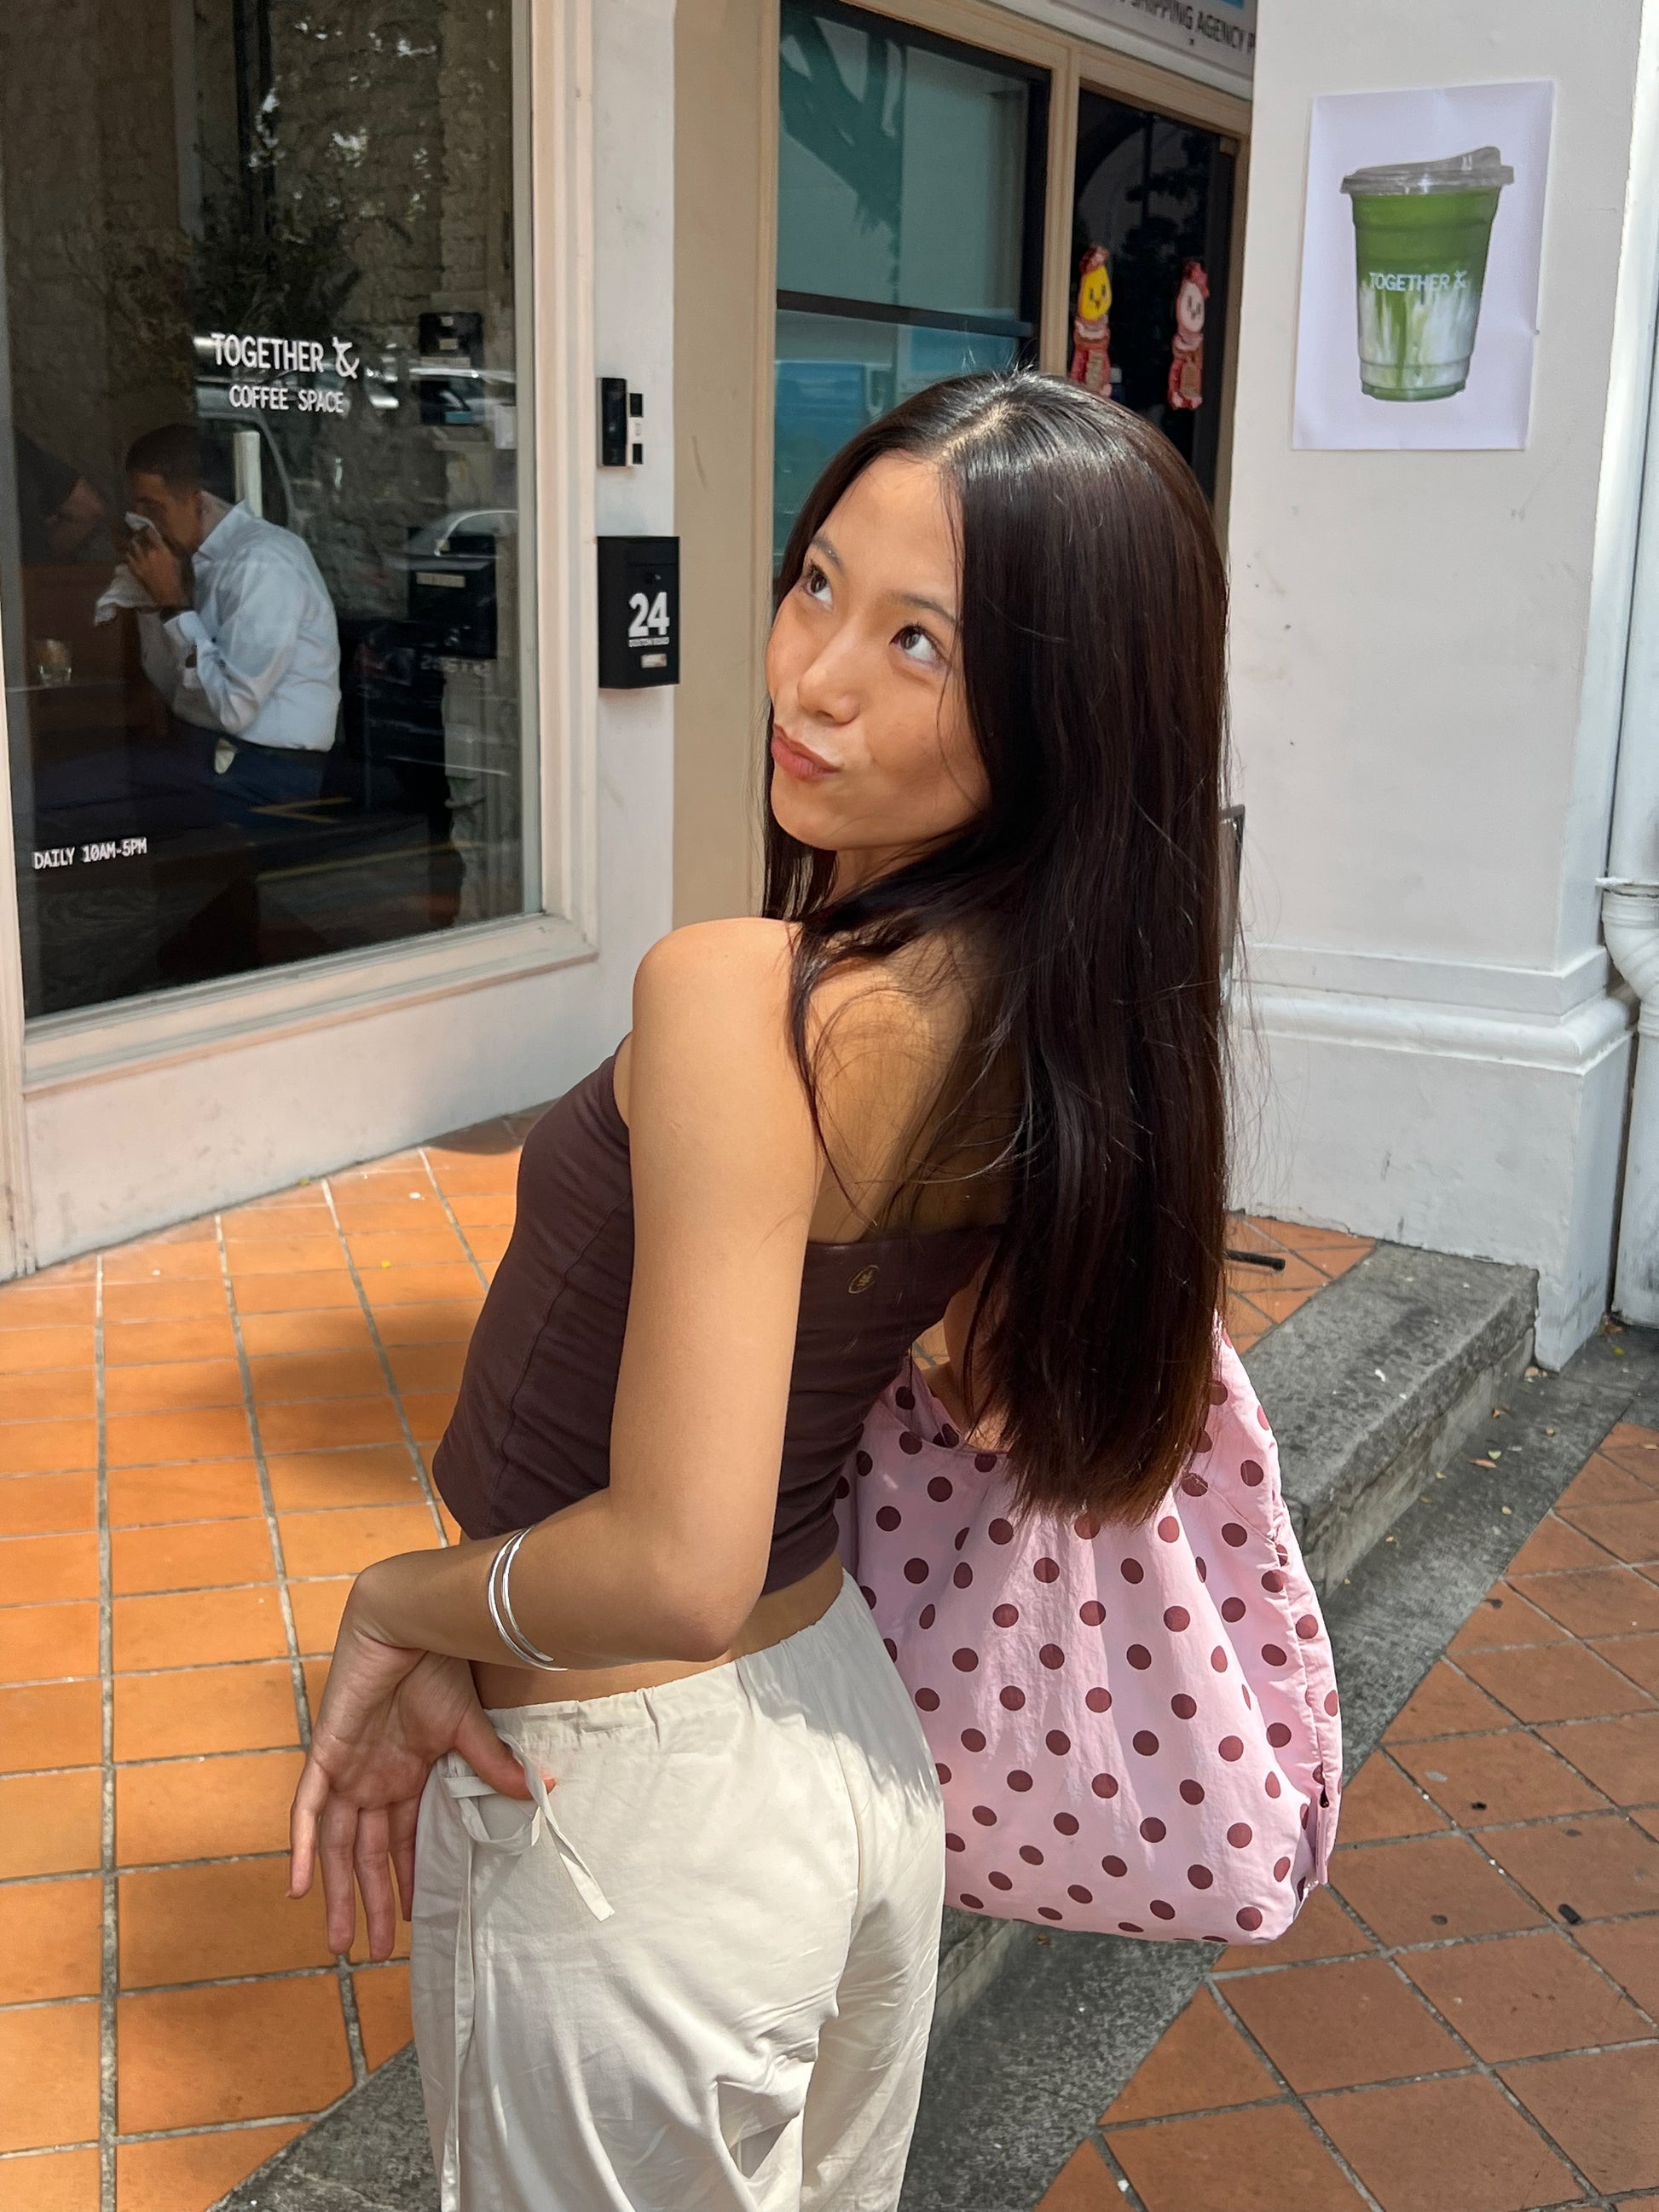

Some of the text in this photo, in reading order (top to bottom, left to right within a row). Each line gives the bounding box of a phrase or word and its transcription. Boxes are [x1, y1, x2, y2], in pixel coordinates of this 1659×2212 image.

[1195, 10, 1244, 53] AGENCY
[1369, 272, 1450, 292] TOGETHER
[211, 332, 325, 373] TOGETHER
[228, 384, 344, 413] COFFEE SPACE
[628, 592, 670, 638] 24
[33, 836, 147, 870] DAILY 10AM-5PM
